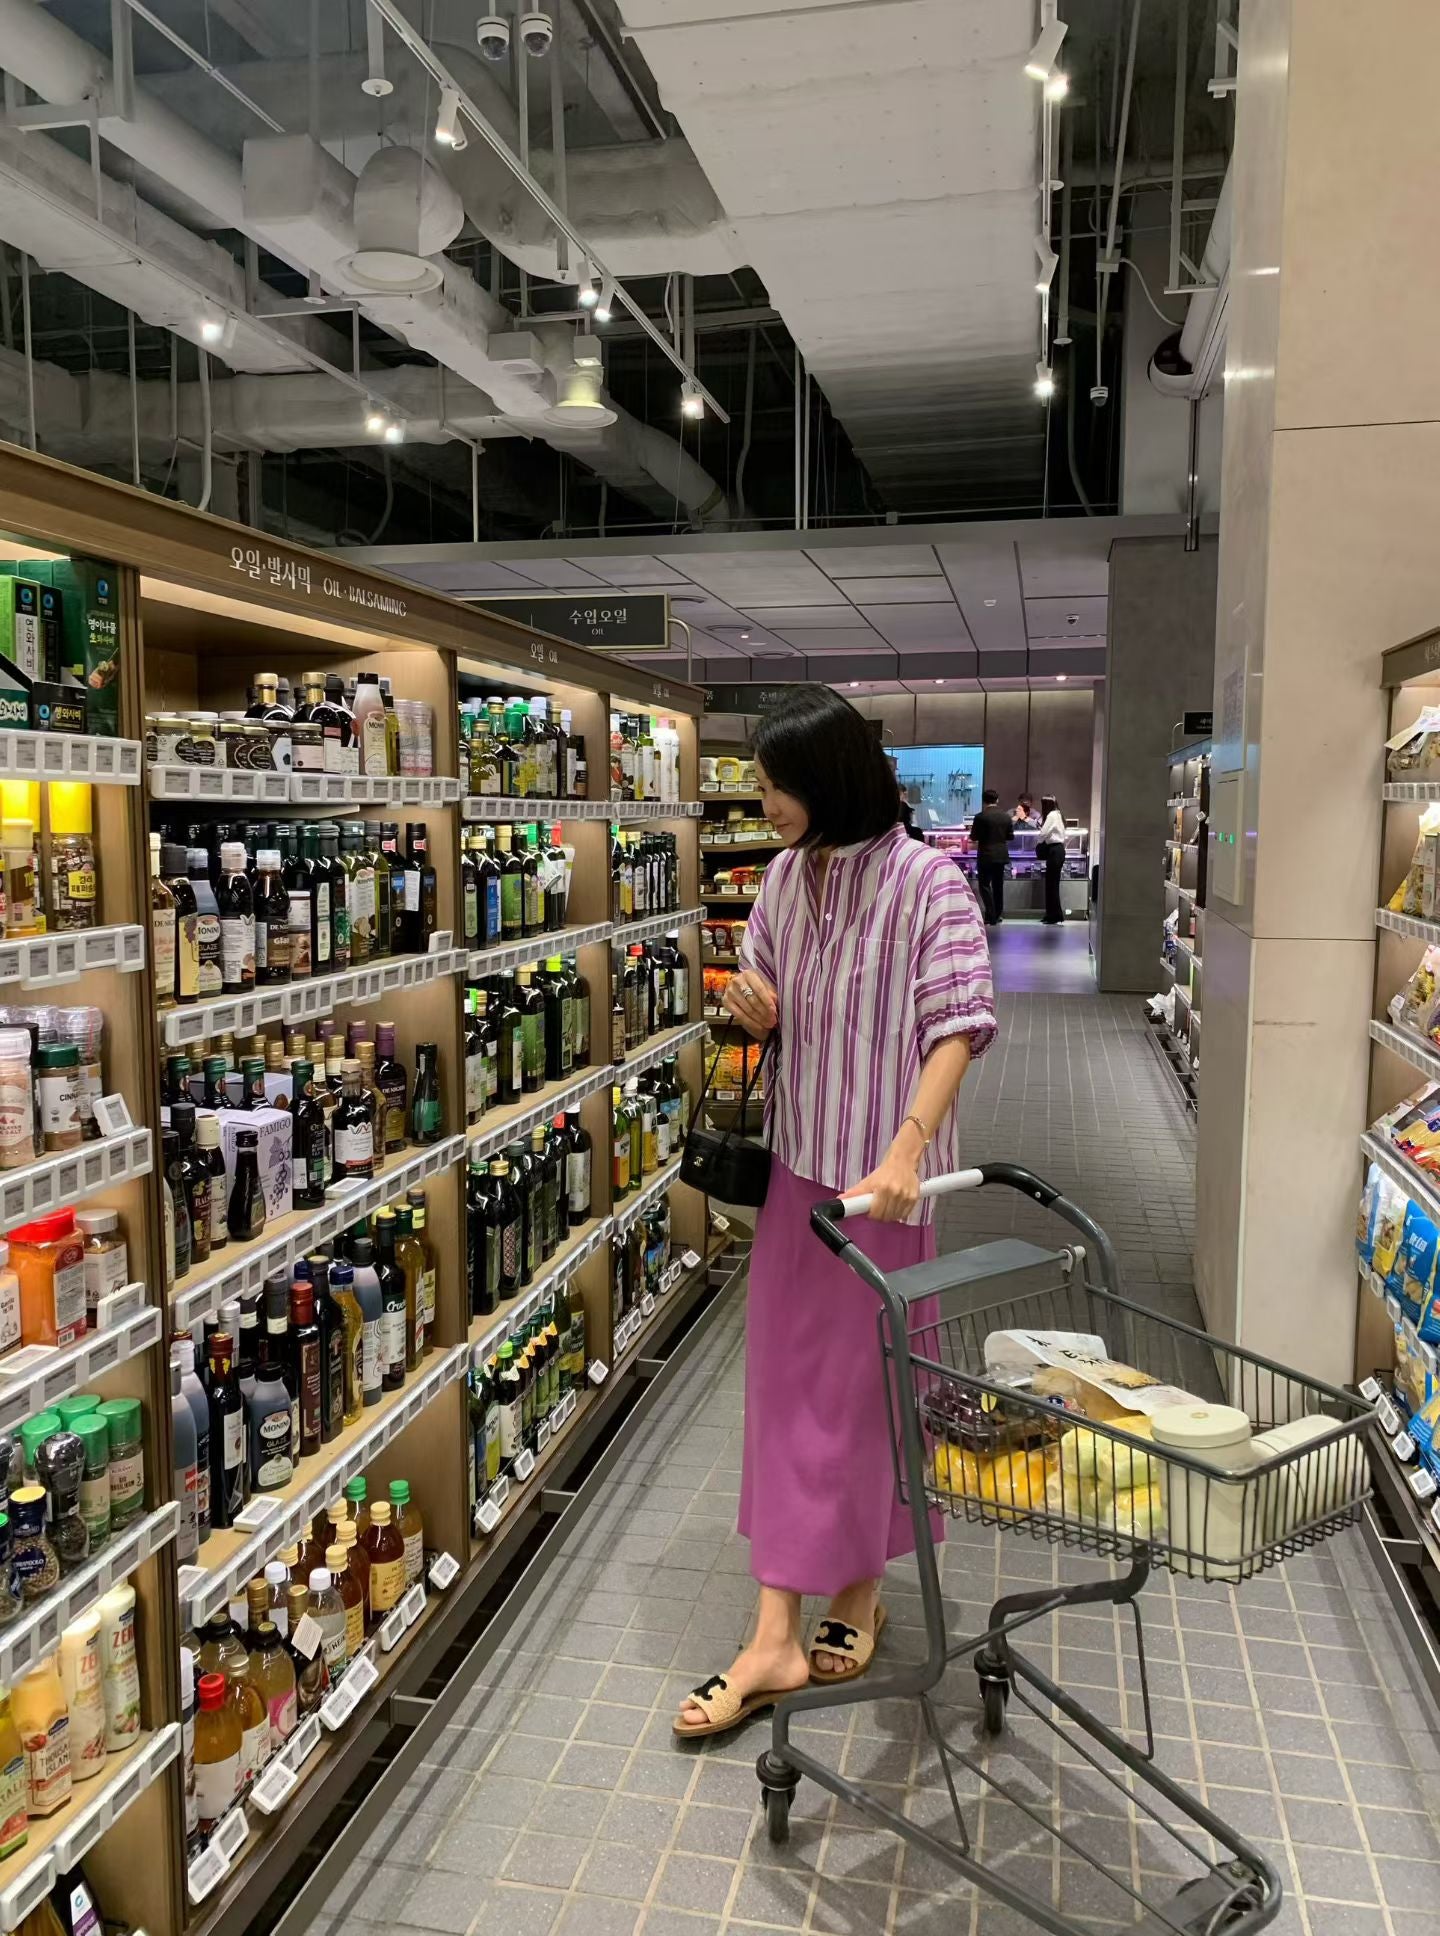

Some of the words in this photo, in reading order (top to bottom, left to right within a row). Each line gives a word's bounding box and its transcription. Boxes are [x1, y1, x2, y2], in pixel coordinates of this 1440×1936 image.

[229, 547, 311, 594] 오일·발사믹
[569, 608, 627, 625] 수입오일
[530, 643, 544, 663] 오일
[260, 1118, 291, 1138] FAMIGO
